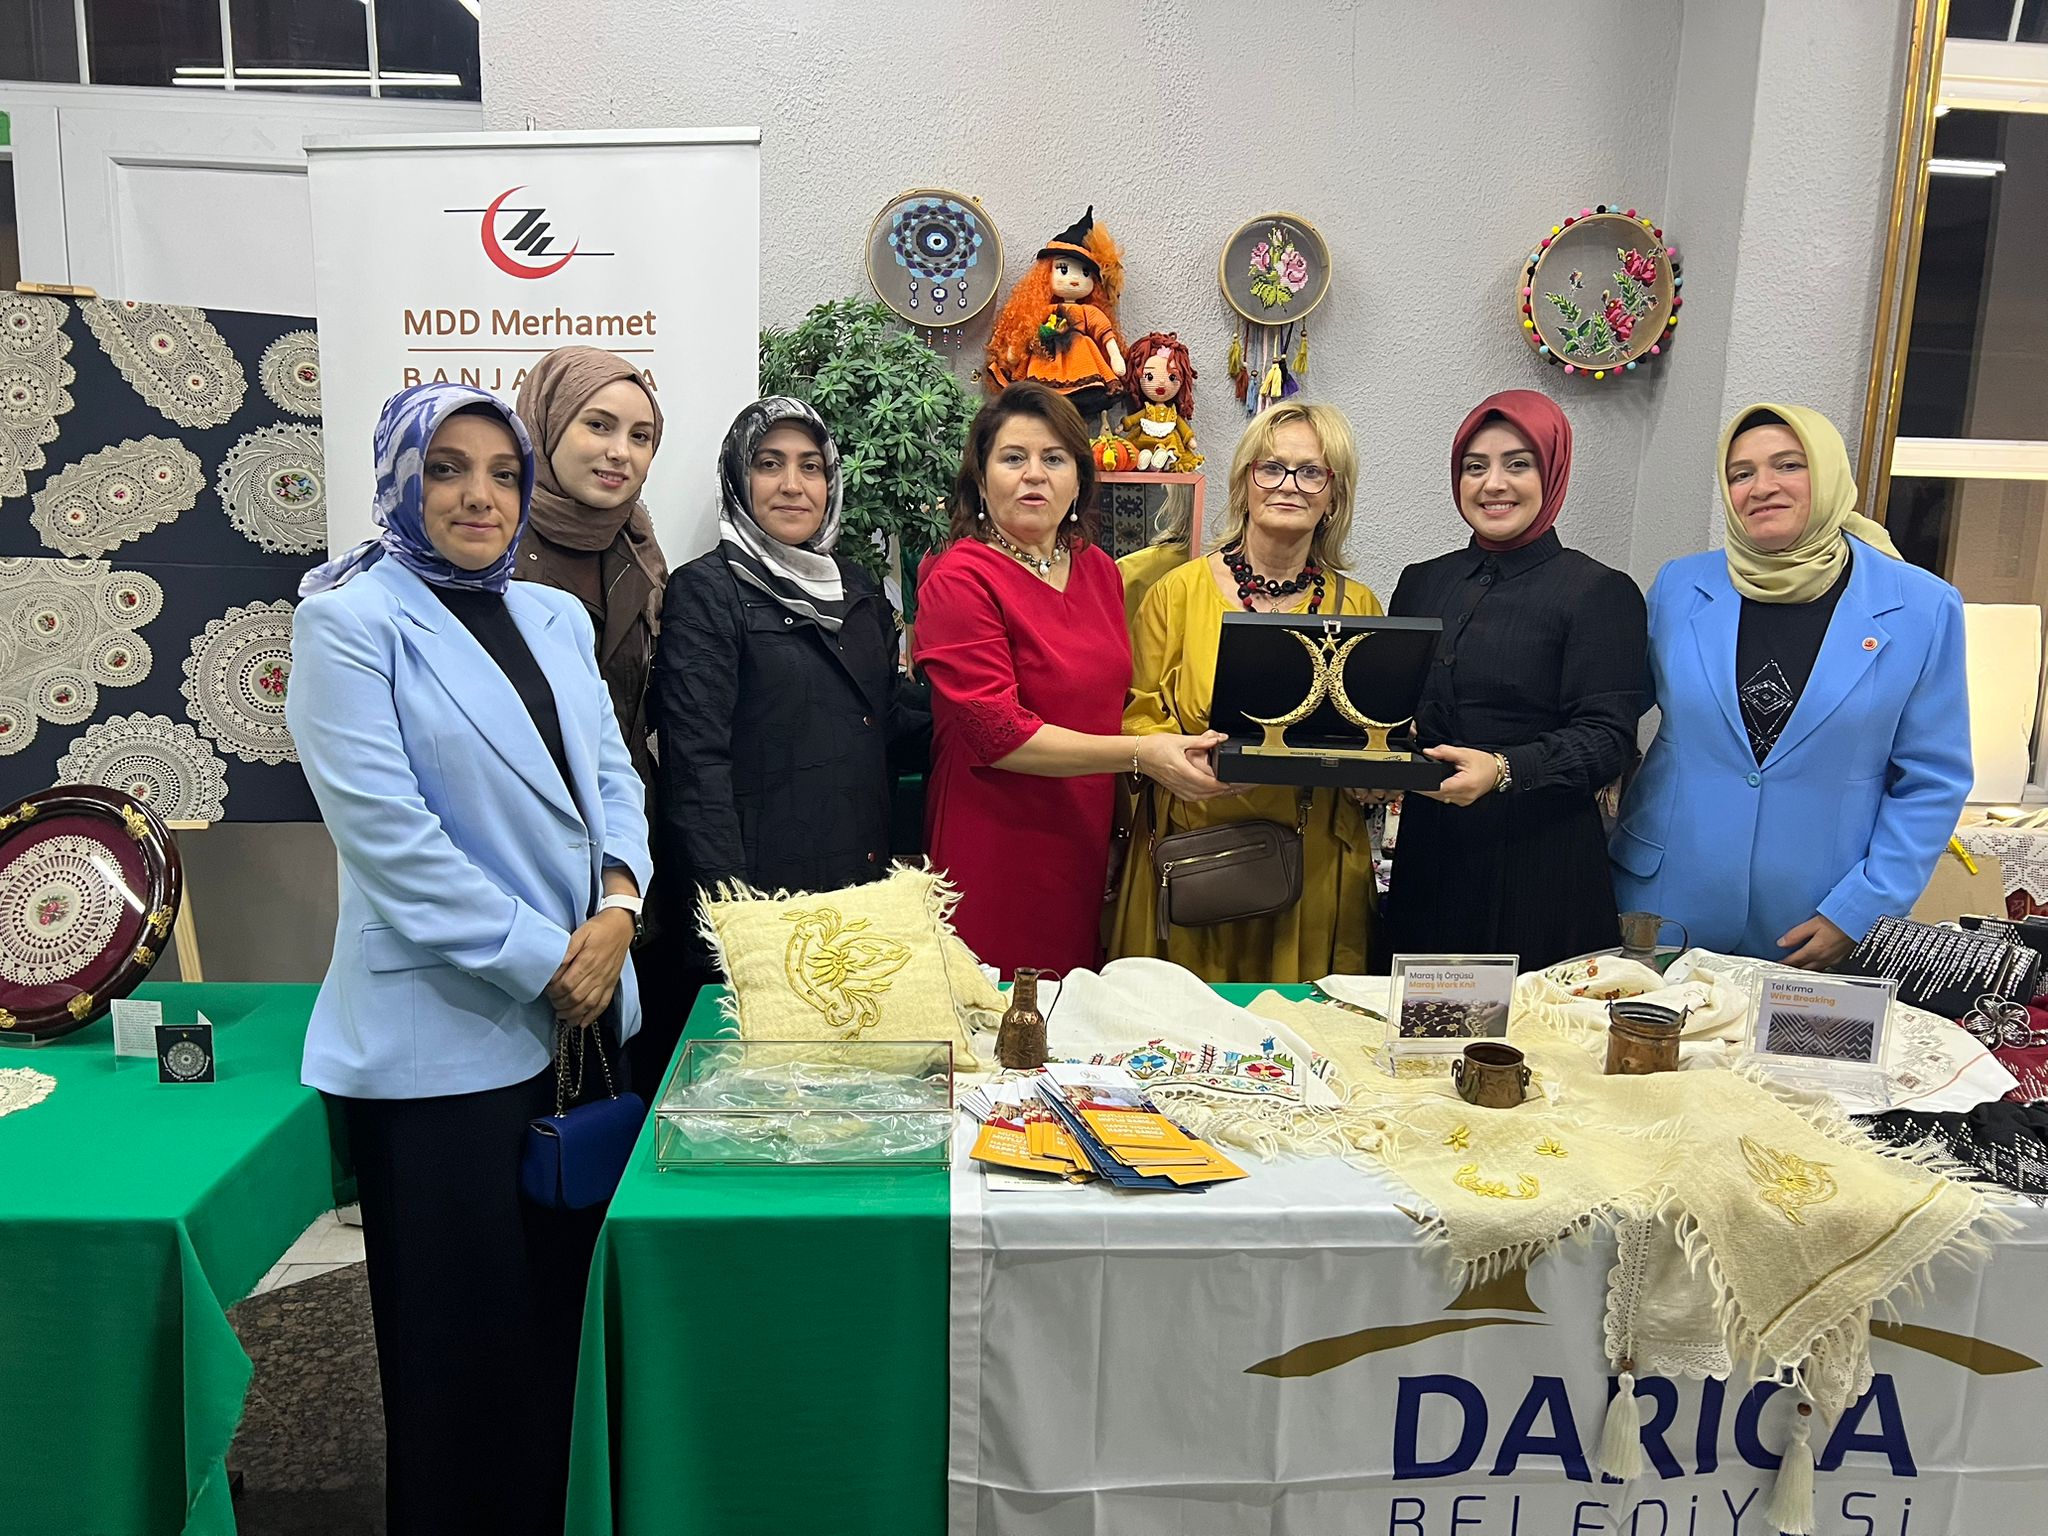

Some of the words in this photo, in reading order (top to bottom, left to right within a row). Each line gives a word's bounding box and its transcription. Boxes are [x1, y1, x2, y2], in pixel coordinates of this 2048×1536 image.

[404, 309, 480, 336] MDD
[492, 307, 657, 336] Merhamet
[1793, 994, 1836, 1008] Breaking
